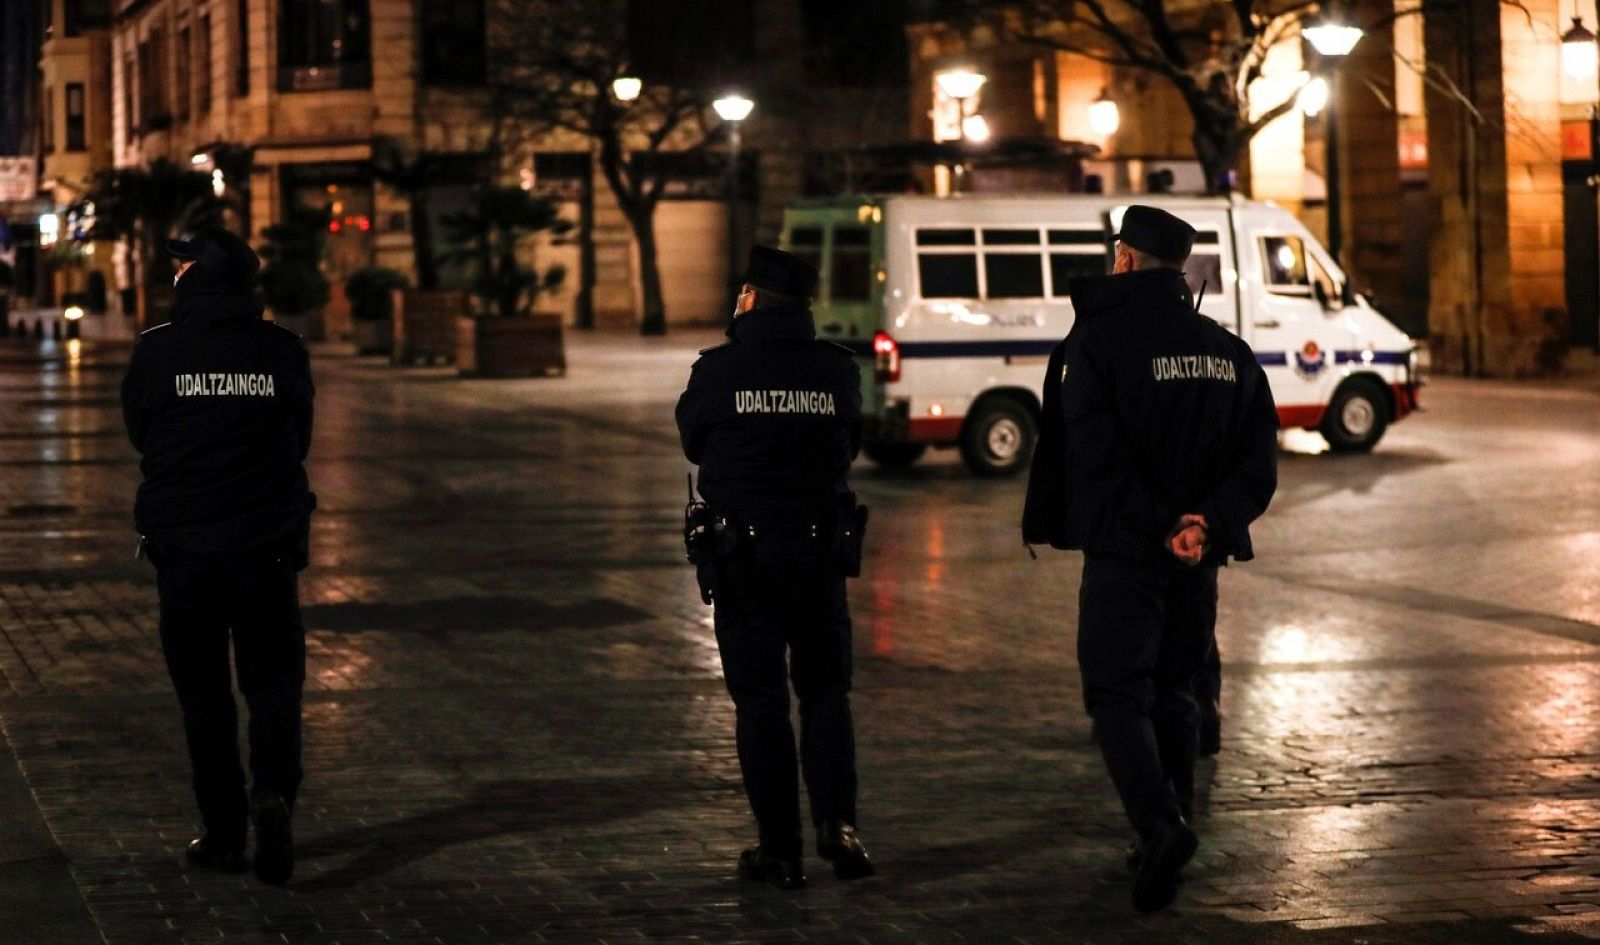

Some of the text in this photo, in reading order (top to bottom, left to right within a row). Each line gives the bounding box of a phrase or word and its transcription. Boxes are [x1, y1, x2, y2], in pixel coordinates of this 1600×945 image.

[1152, 355, 1237, 383] UDALTZAINGOA
[175, 372, 275, 397] UDALTZAINGOA
[735, 389, 836, 416] UDALTZAINGOA
